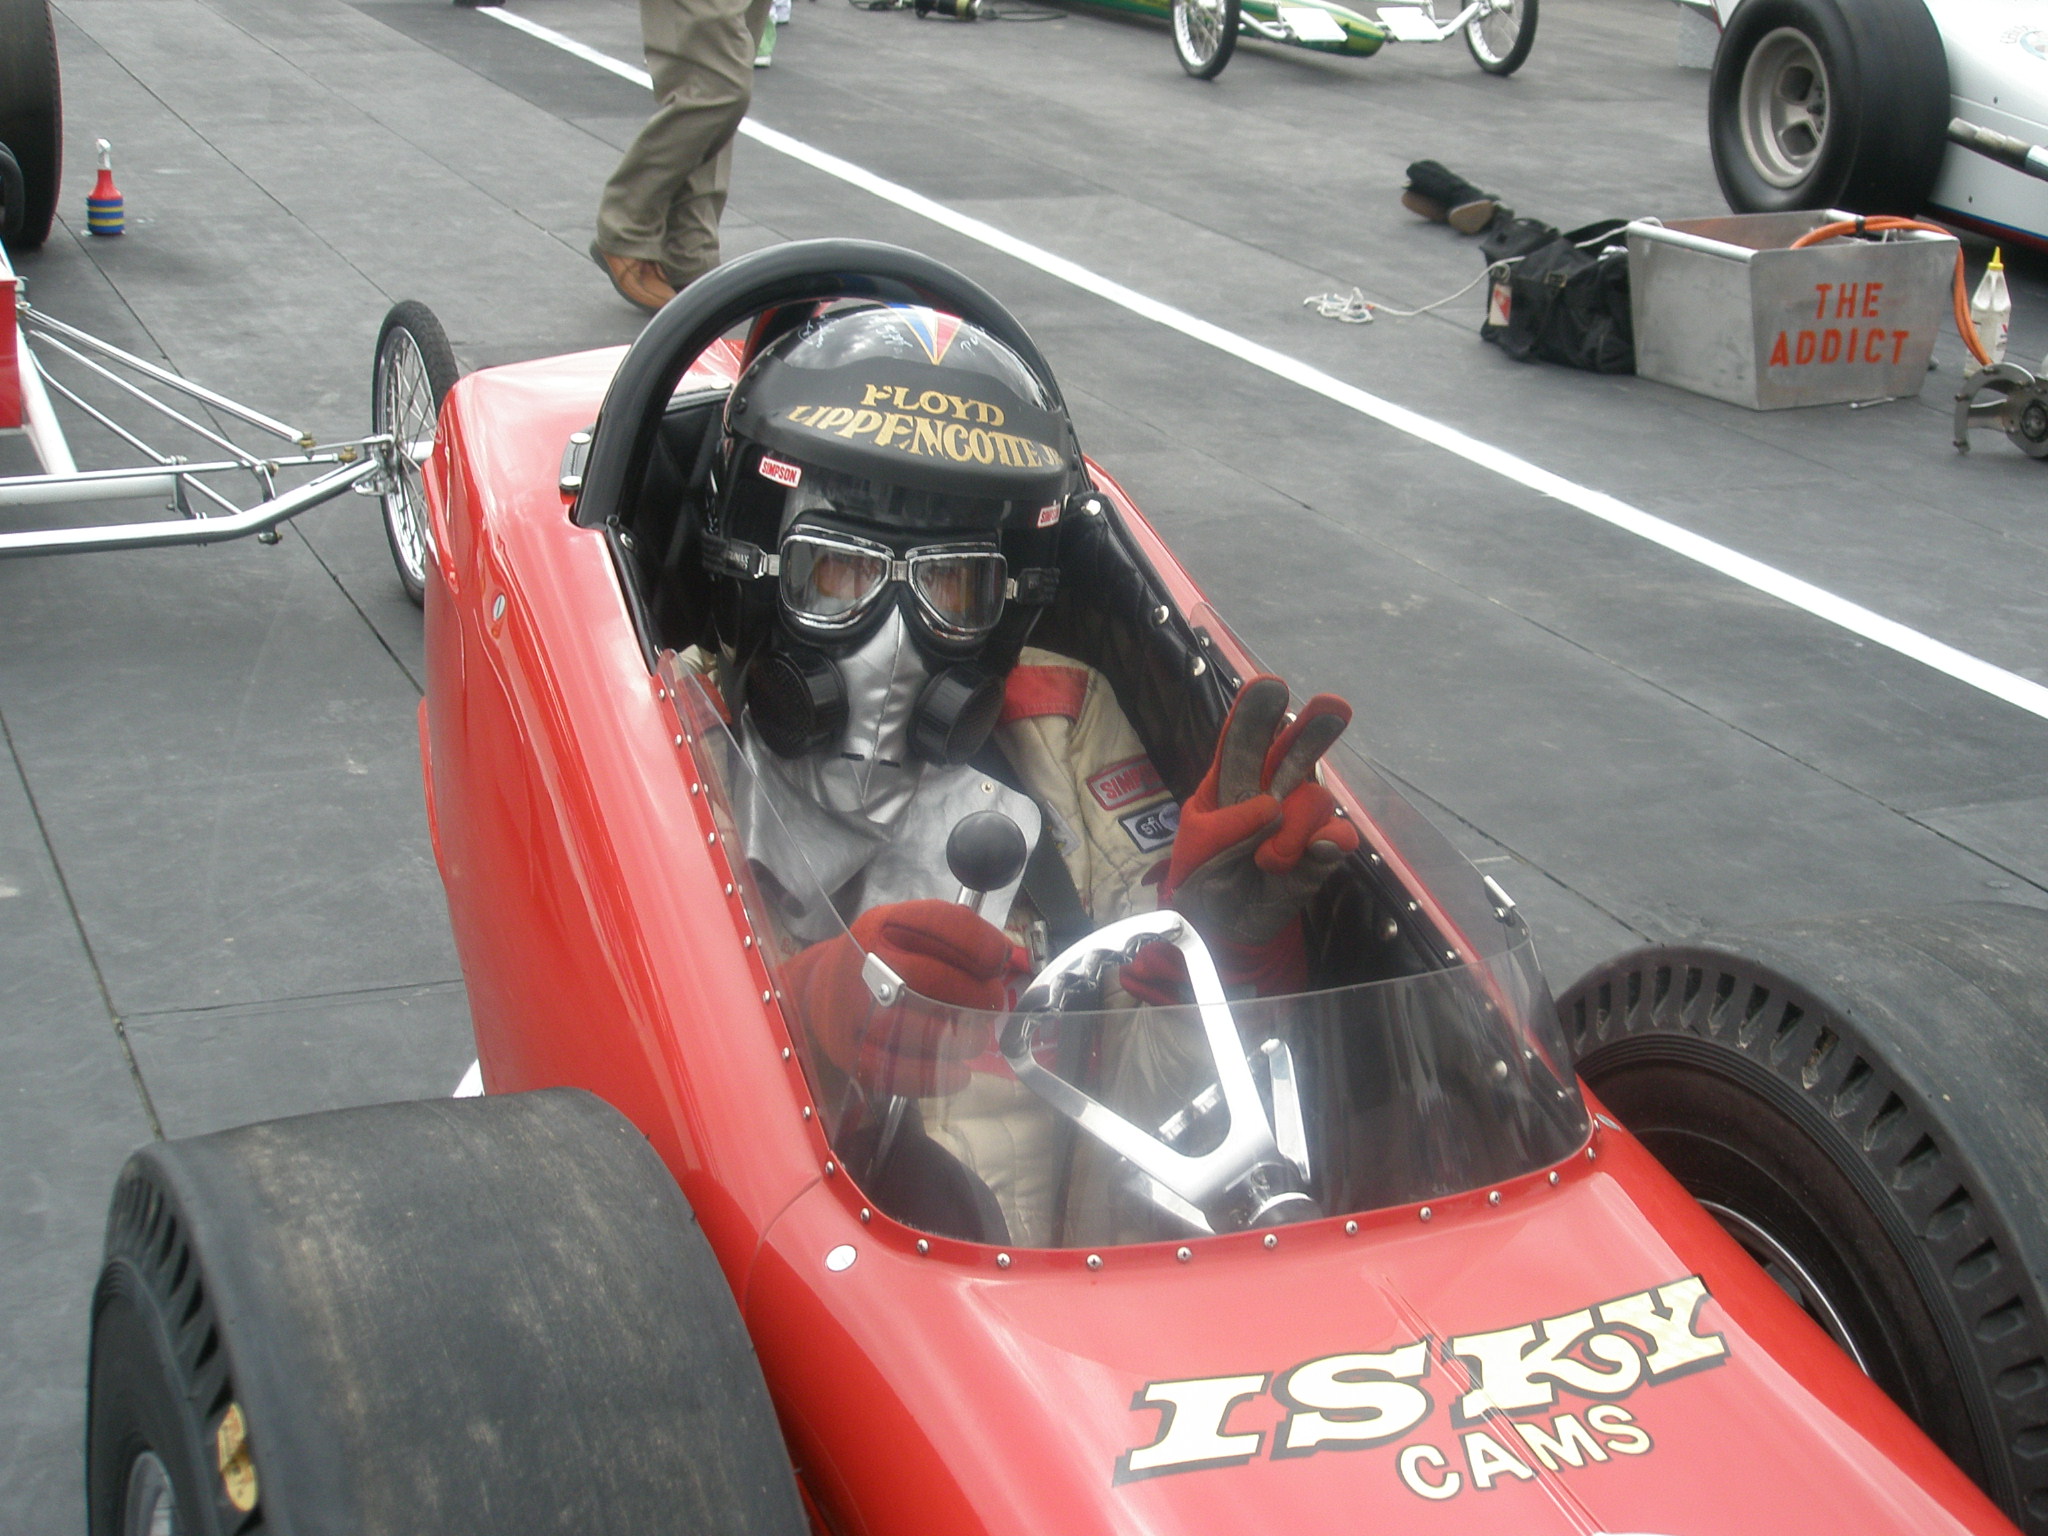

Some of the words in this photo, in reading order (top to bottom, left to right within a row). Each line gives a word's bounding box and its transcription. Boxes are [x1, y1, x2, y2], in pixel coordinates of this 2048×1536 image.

[1815, 282, 1884, 319] THE
[1769, 327, 1909, 367] ADDICT
[860, 384, 1005, 427] FLOYD
[762, 461, 797, 483] SIMPSON
[1115, 1275, 1730, 1485] ISKY
[1399, 1404, 1652, 1501] CAMS
